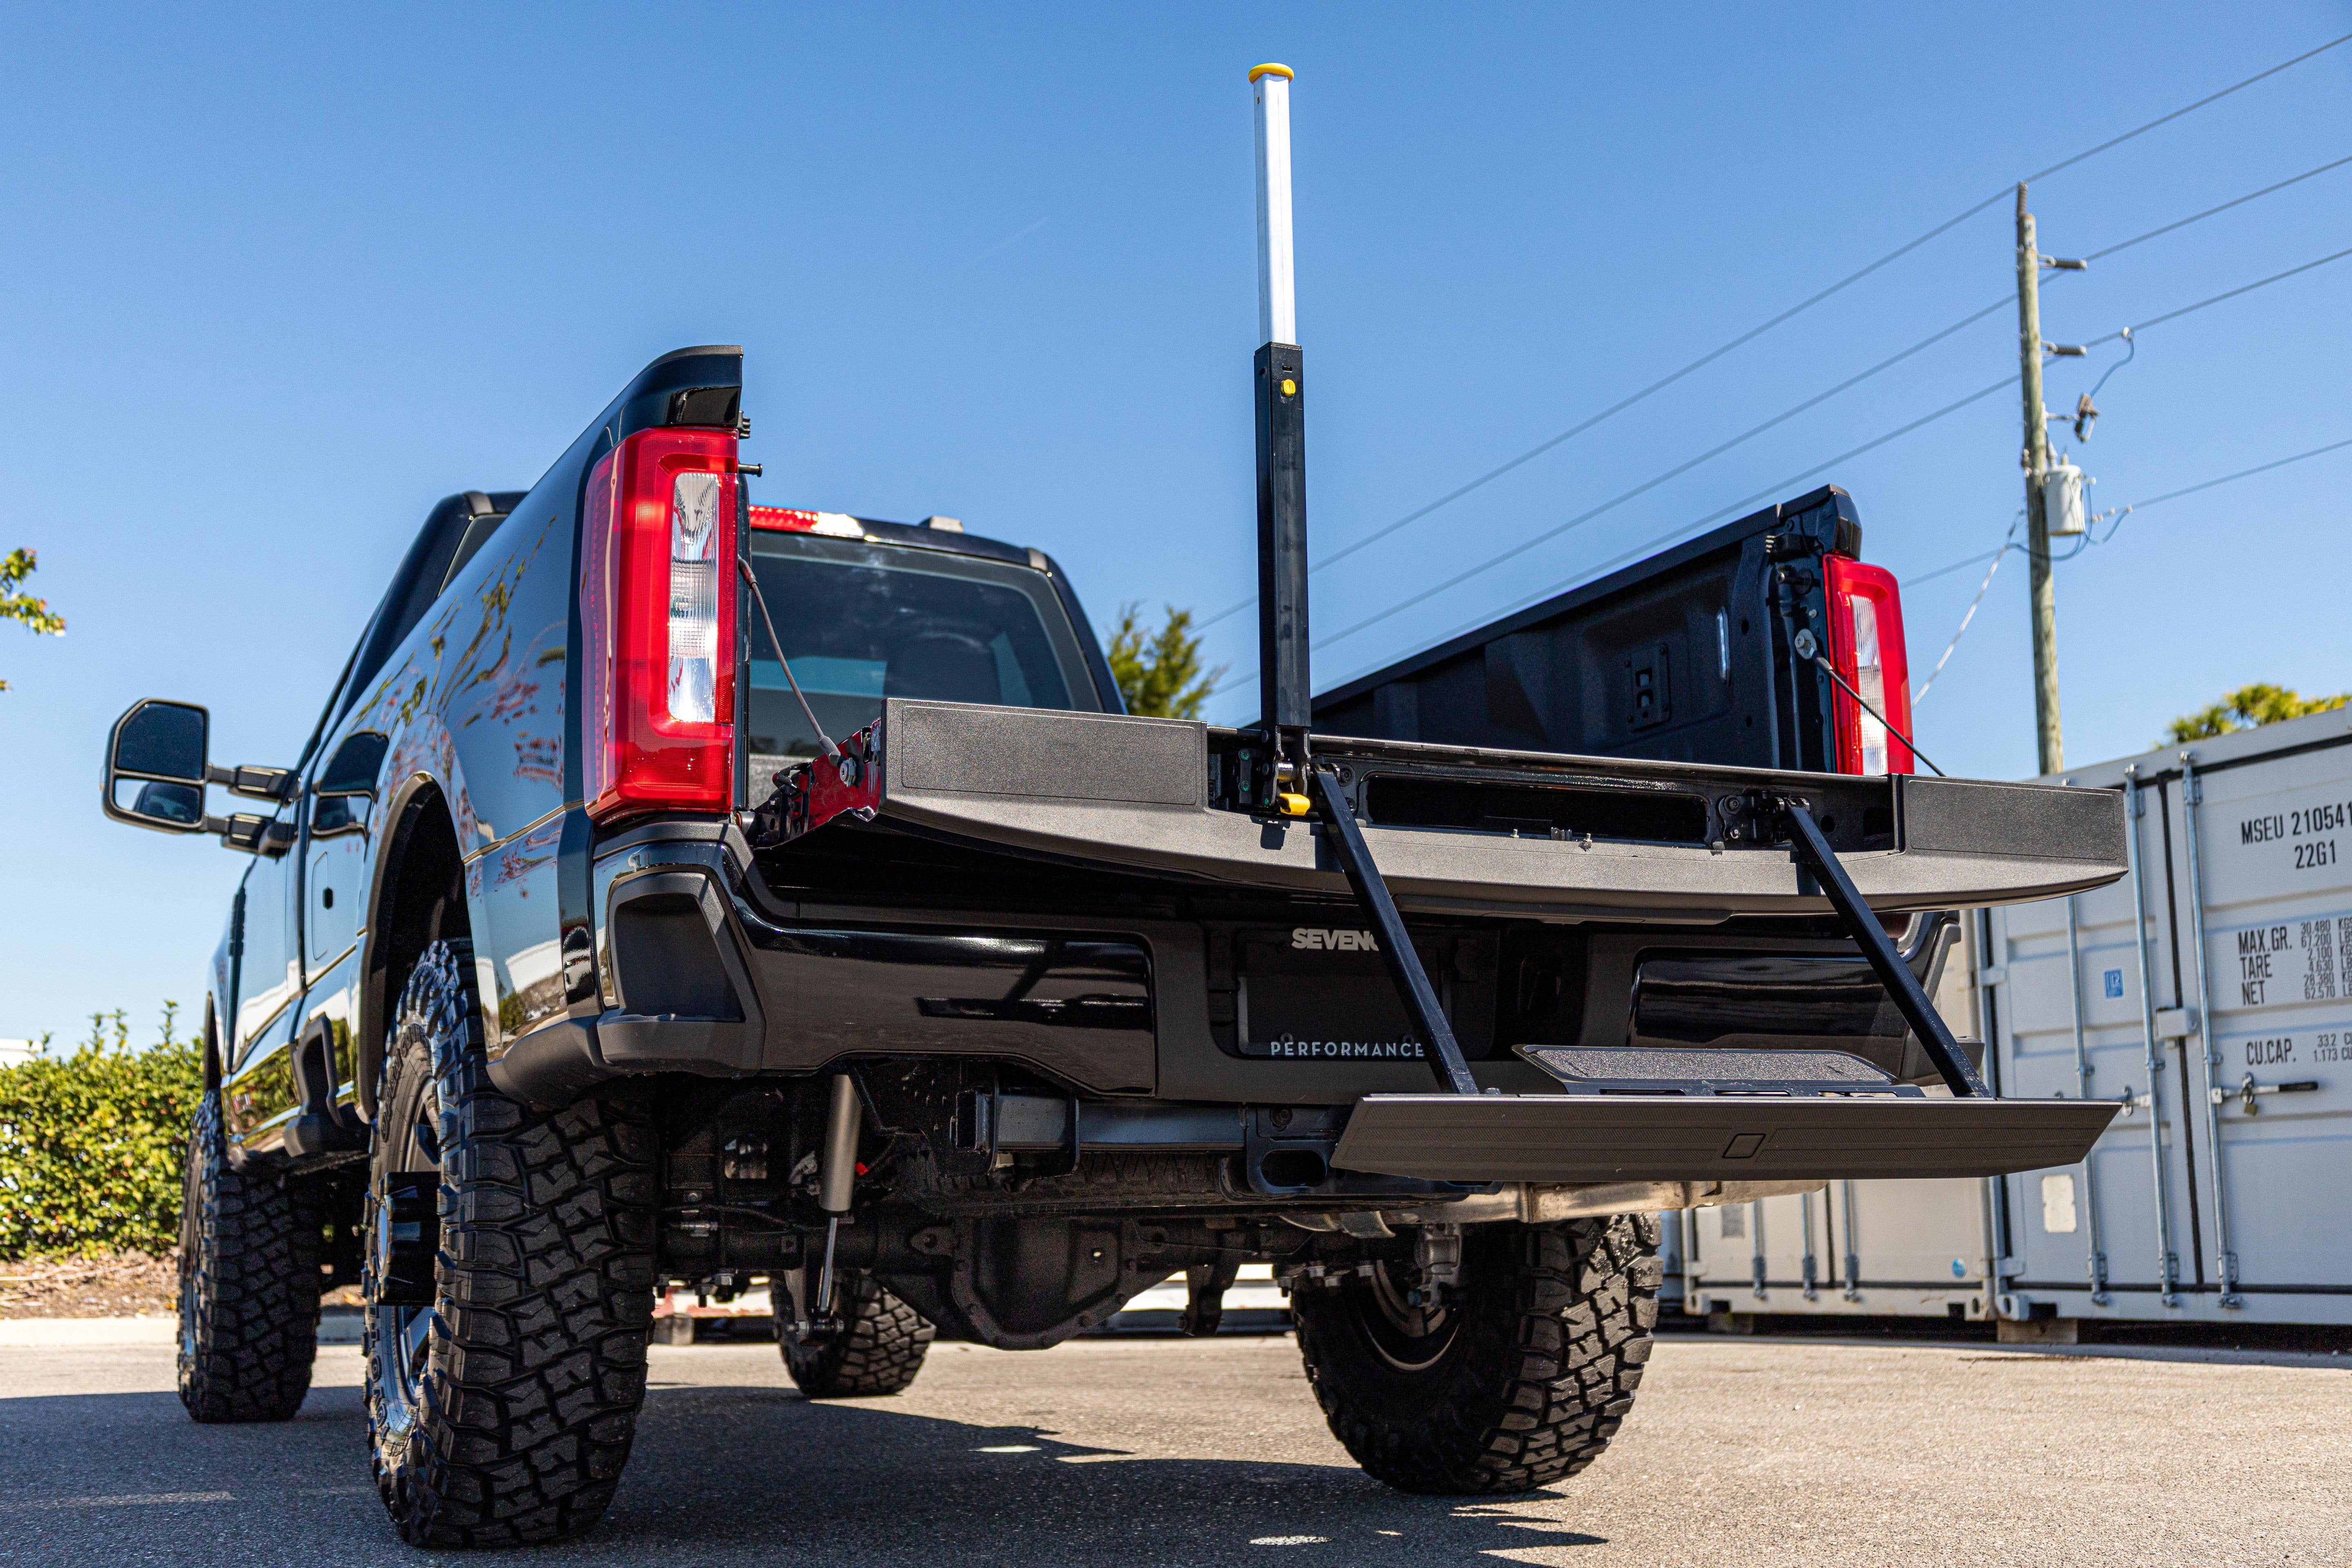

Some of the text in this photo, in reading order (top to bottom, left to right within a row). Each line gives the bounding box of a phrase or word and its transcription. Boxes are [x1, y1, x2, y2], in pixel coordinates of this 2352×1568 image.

[2241, 814, 2284, 845] MSEU
[2294, 839, 2336, 869] 22G1
[2238, 926, 2292, 955] MAX.GR.
[2240, 953, 2273, 980] TARE
[2242, 980, 2265, 1006] NET
[1270, 1041, 1425, 1057] PERFORMANCE
